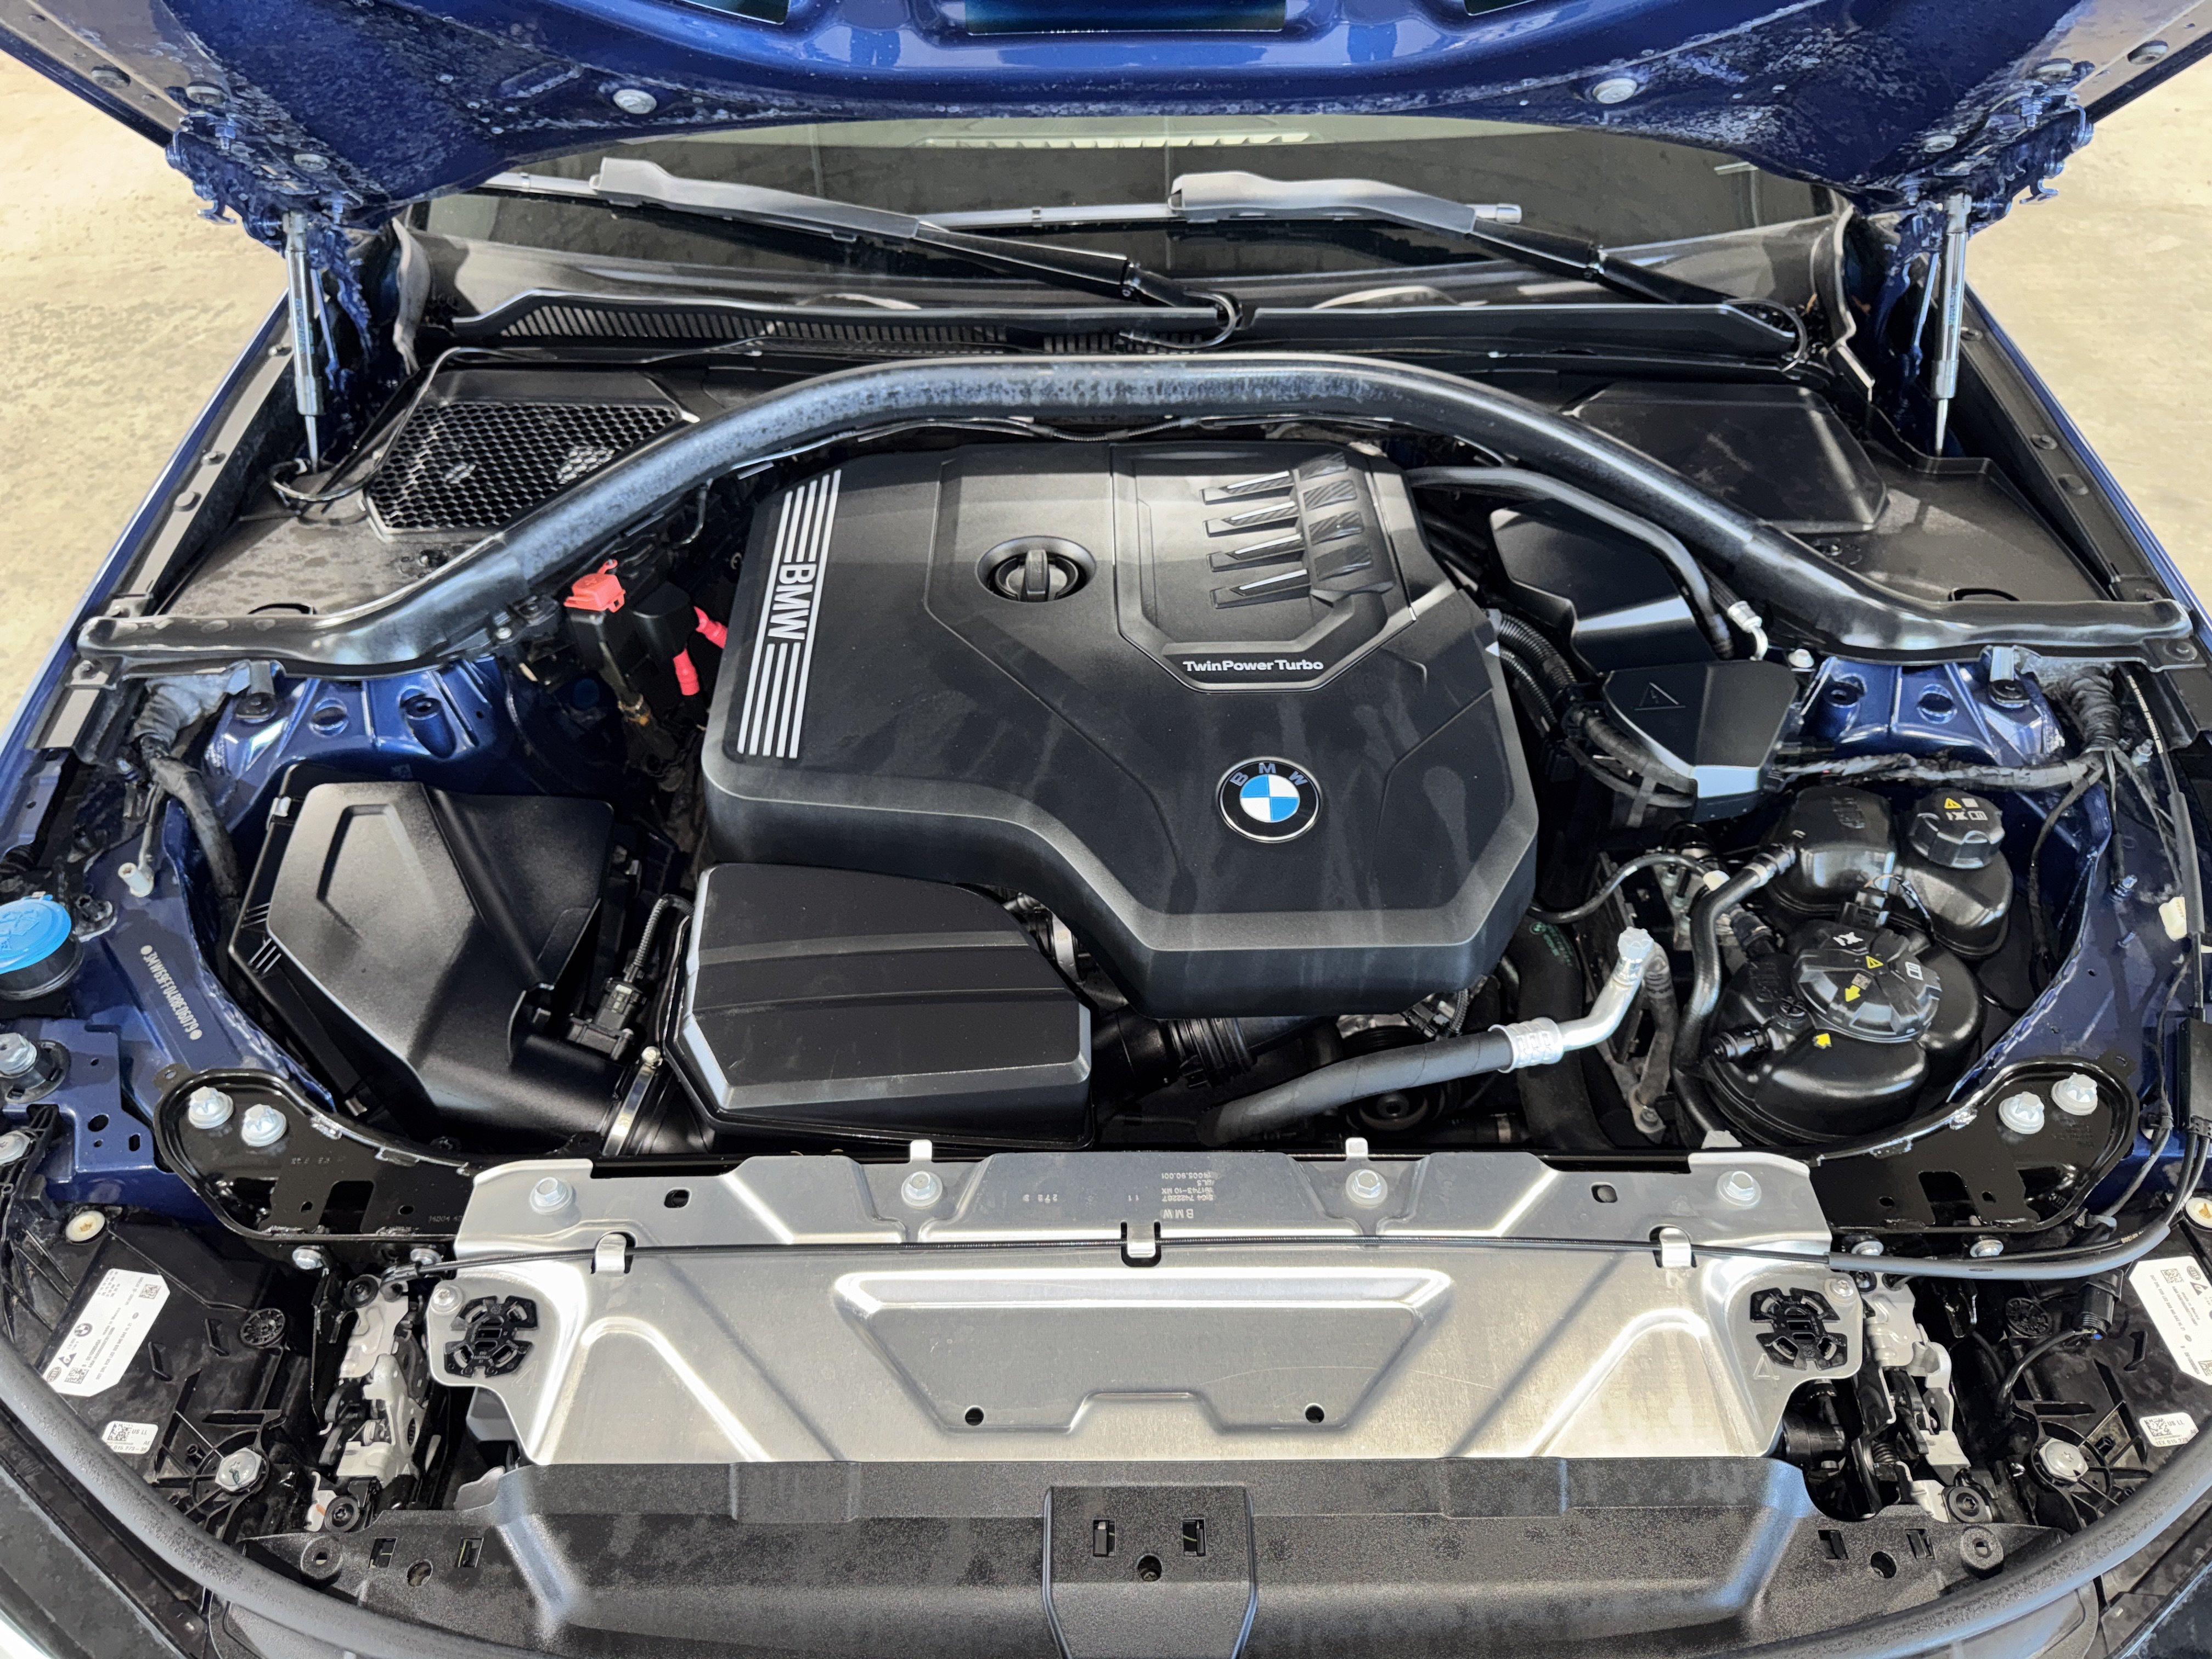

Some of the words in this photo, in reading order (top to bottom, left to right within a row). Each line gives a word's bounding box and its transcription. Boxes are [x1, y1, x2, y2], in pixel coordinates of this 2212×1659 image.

[768, 563, 817, 640] BMW
[1230, 763, 1309, 787] BMW
[1163, 1209, 1194, 1219] BMW
